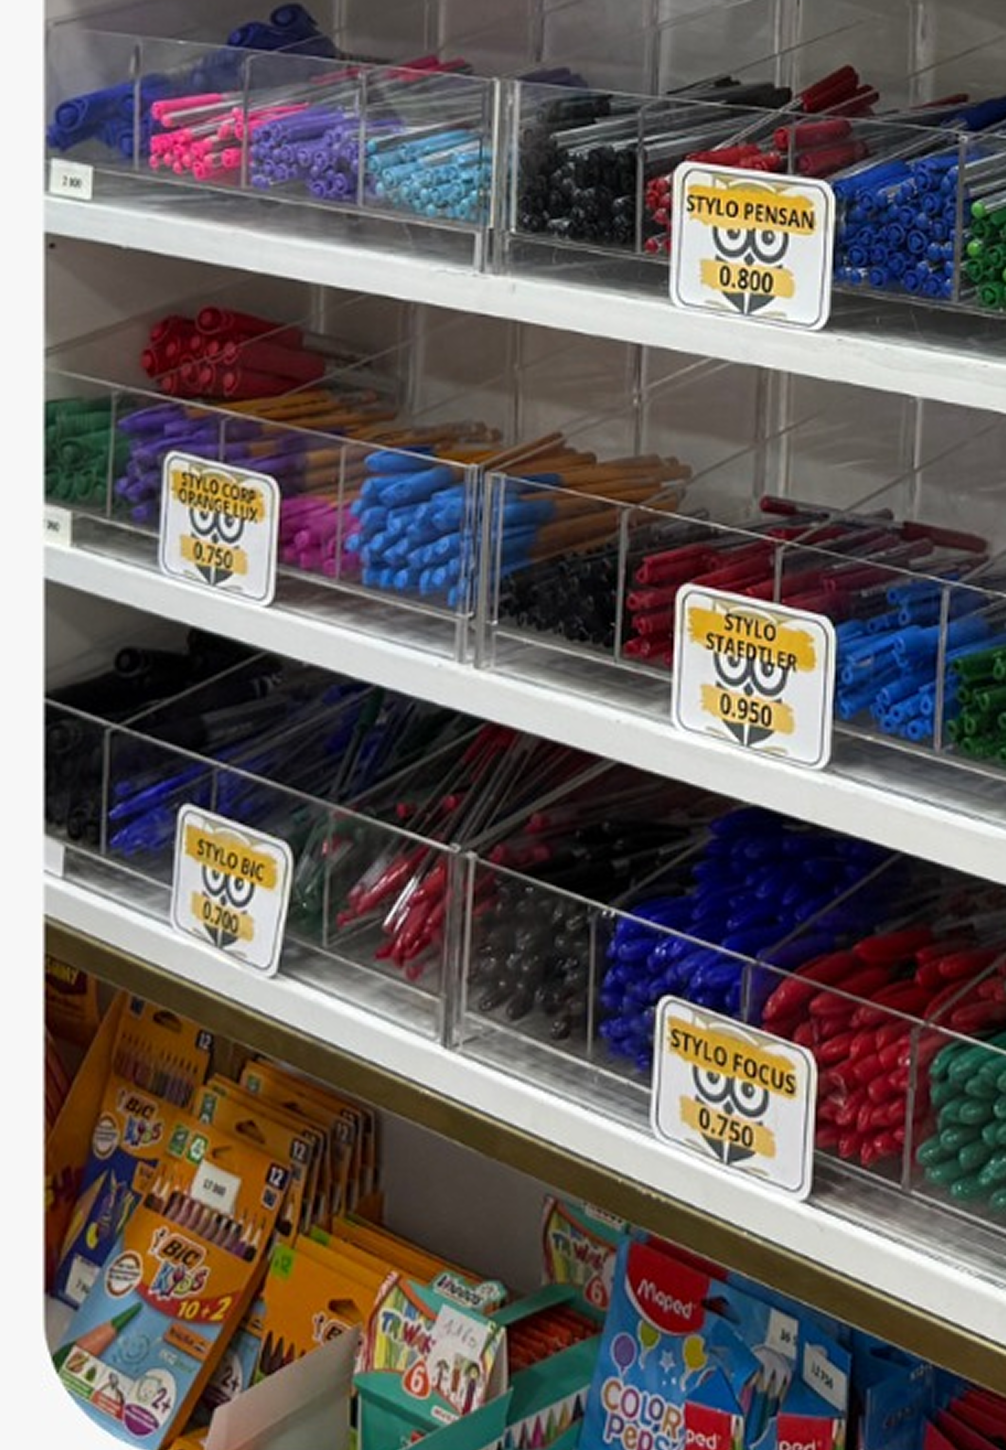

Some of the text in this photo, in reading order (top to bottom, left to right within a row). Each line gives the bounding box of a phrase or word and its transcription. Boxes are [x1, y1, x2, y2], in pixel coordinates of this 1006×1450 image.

[686, 194, 815, 231] STYLO PENSAN
[718, 265, 774, 294] 0.800
[181, 471, 220, 495] STYLO
[178, 488, 259, 525] ORANGE LUX
[193, 541, 234, 570] 0.750
[724, 613, 777, 642] STYLO
[705, 632, 798, 672] STAEDTLER
[719, 692, 773, 728] 0.950
[197, 838, 266, 882] STYLO BIC
[202, 900, 240, 935] 0.700
[669, 1028, 798, 1095] STYLO FOCUS
[698, 1107, 755, 1148] 0.750
[270, 1166, 284, 1188] 12
[636, 1278, 693, 1320] Maped
[410, 1365, 424, 1394] 6
